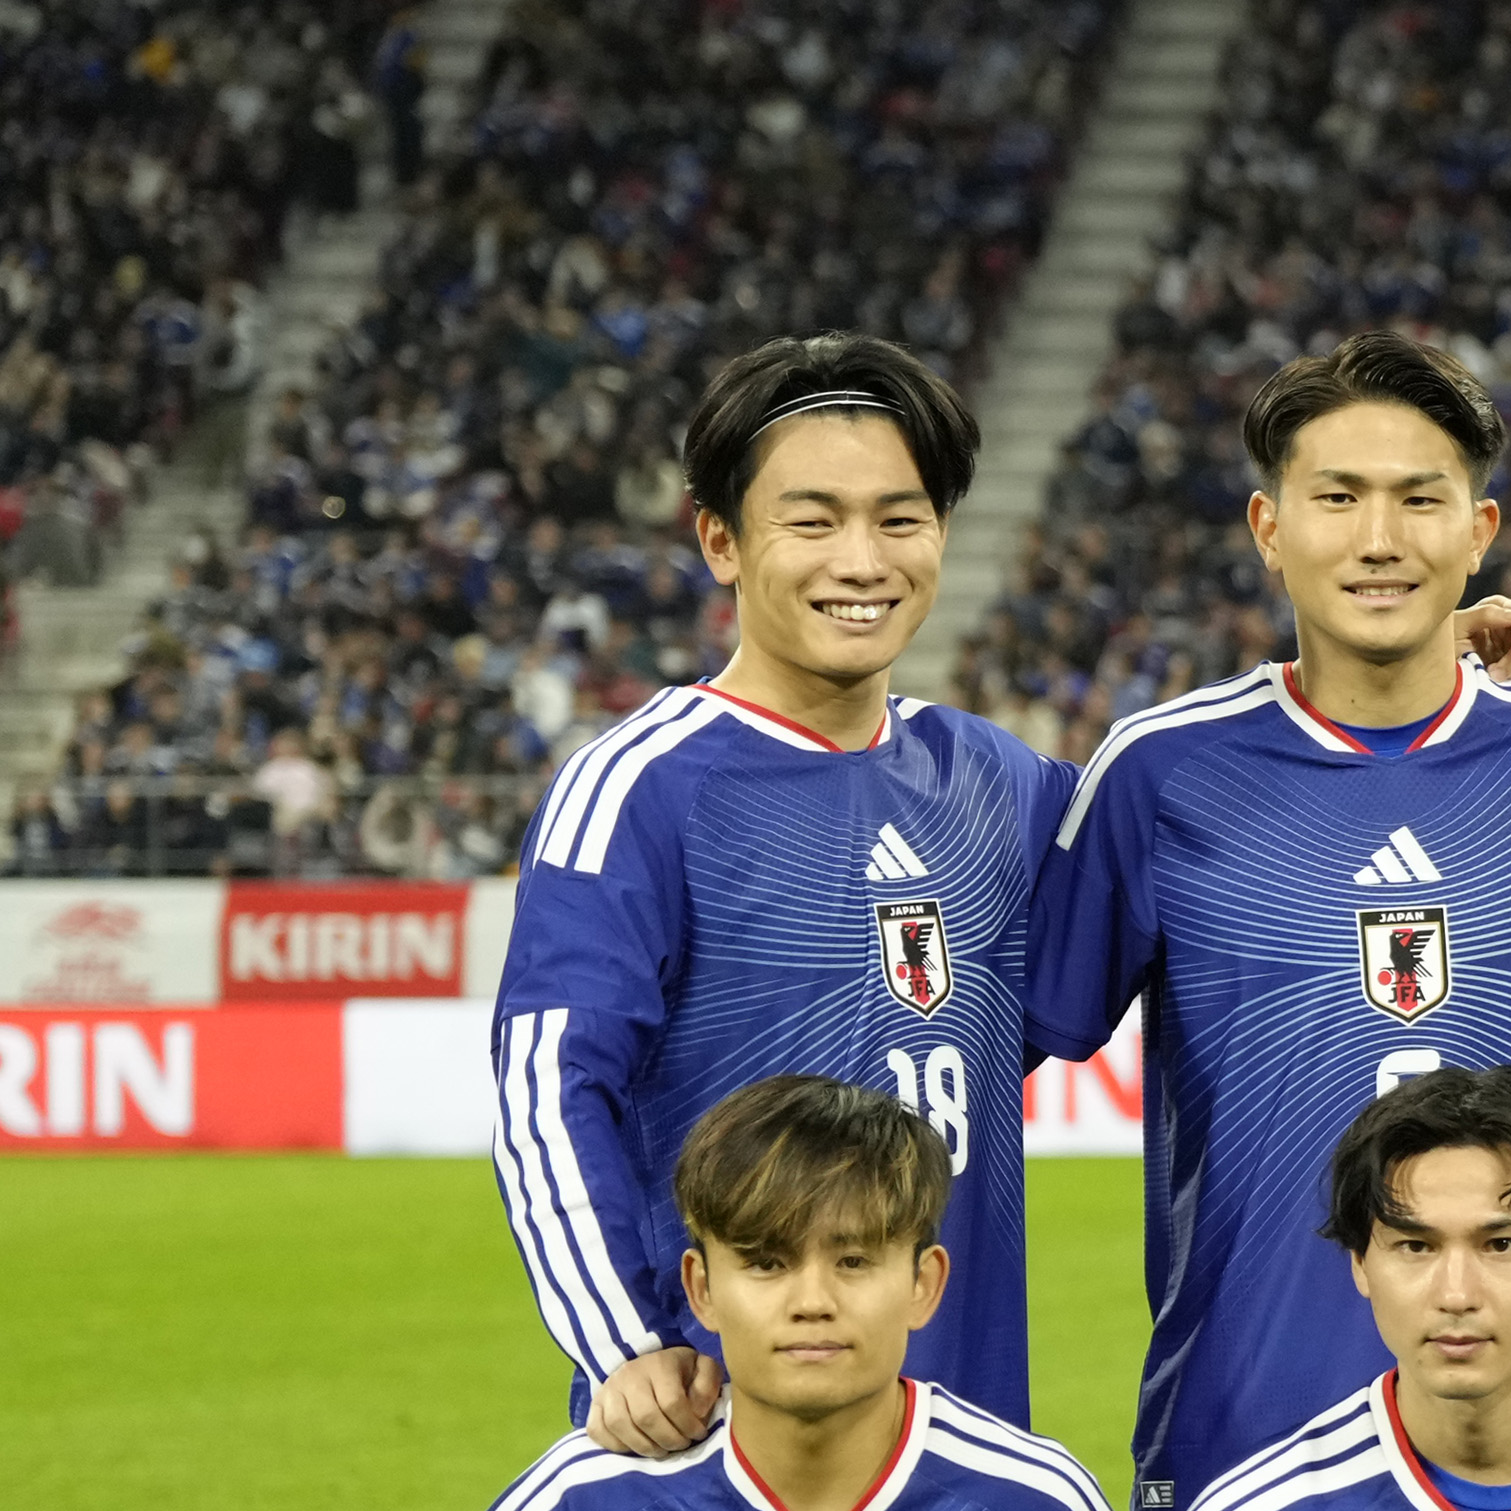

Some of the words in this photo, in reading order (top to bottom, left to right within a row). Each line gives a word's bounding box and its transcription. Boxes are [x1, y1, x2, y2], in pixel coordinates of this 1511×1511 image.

[889, 904, 924, 916] JAPAN
[1379, 911, 1425, 923] JAPAN
[230, 910, 458, 983] KIRIN
[908, 979, 936, 997] JFA
[1388, 985, 1426, 1004] JFA
